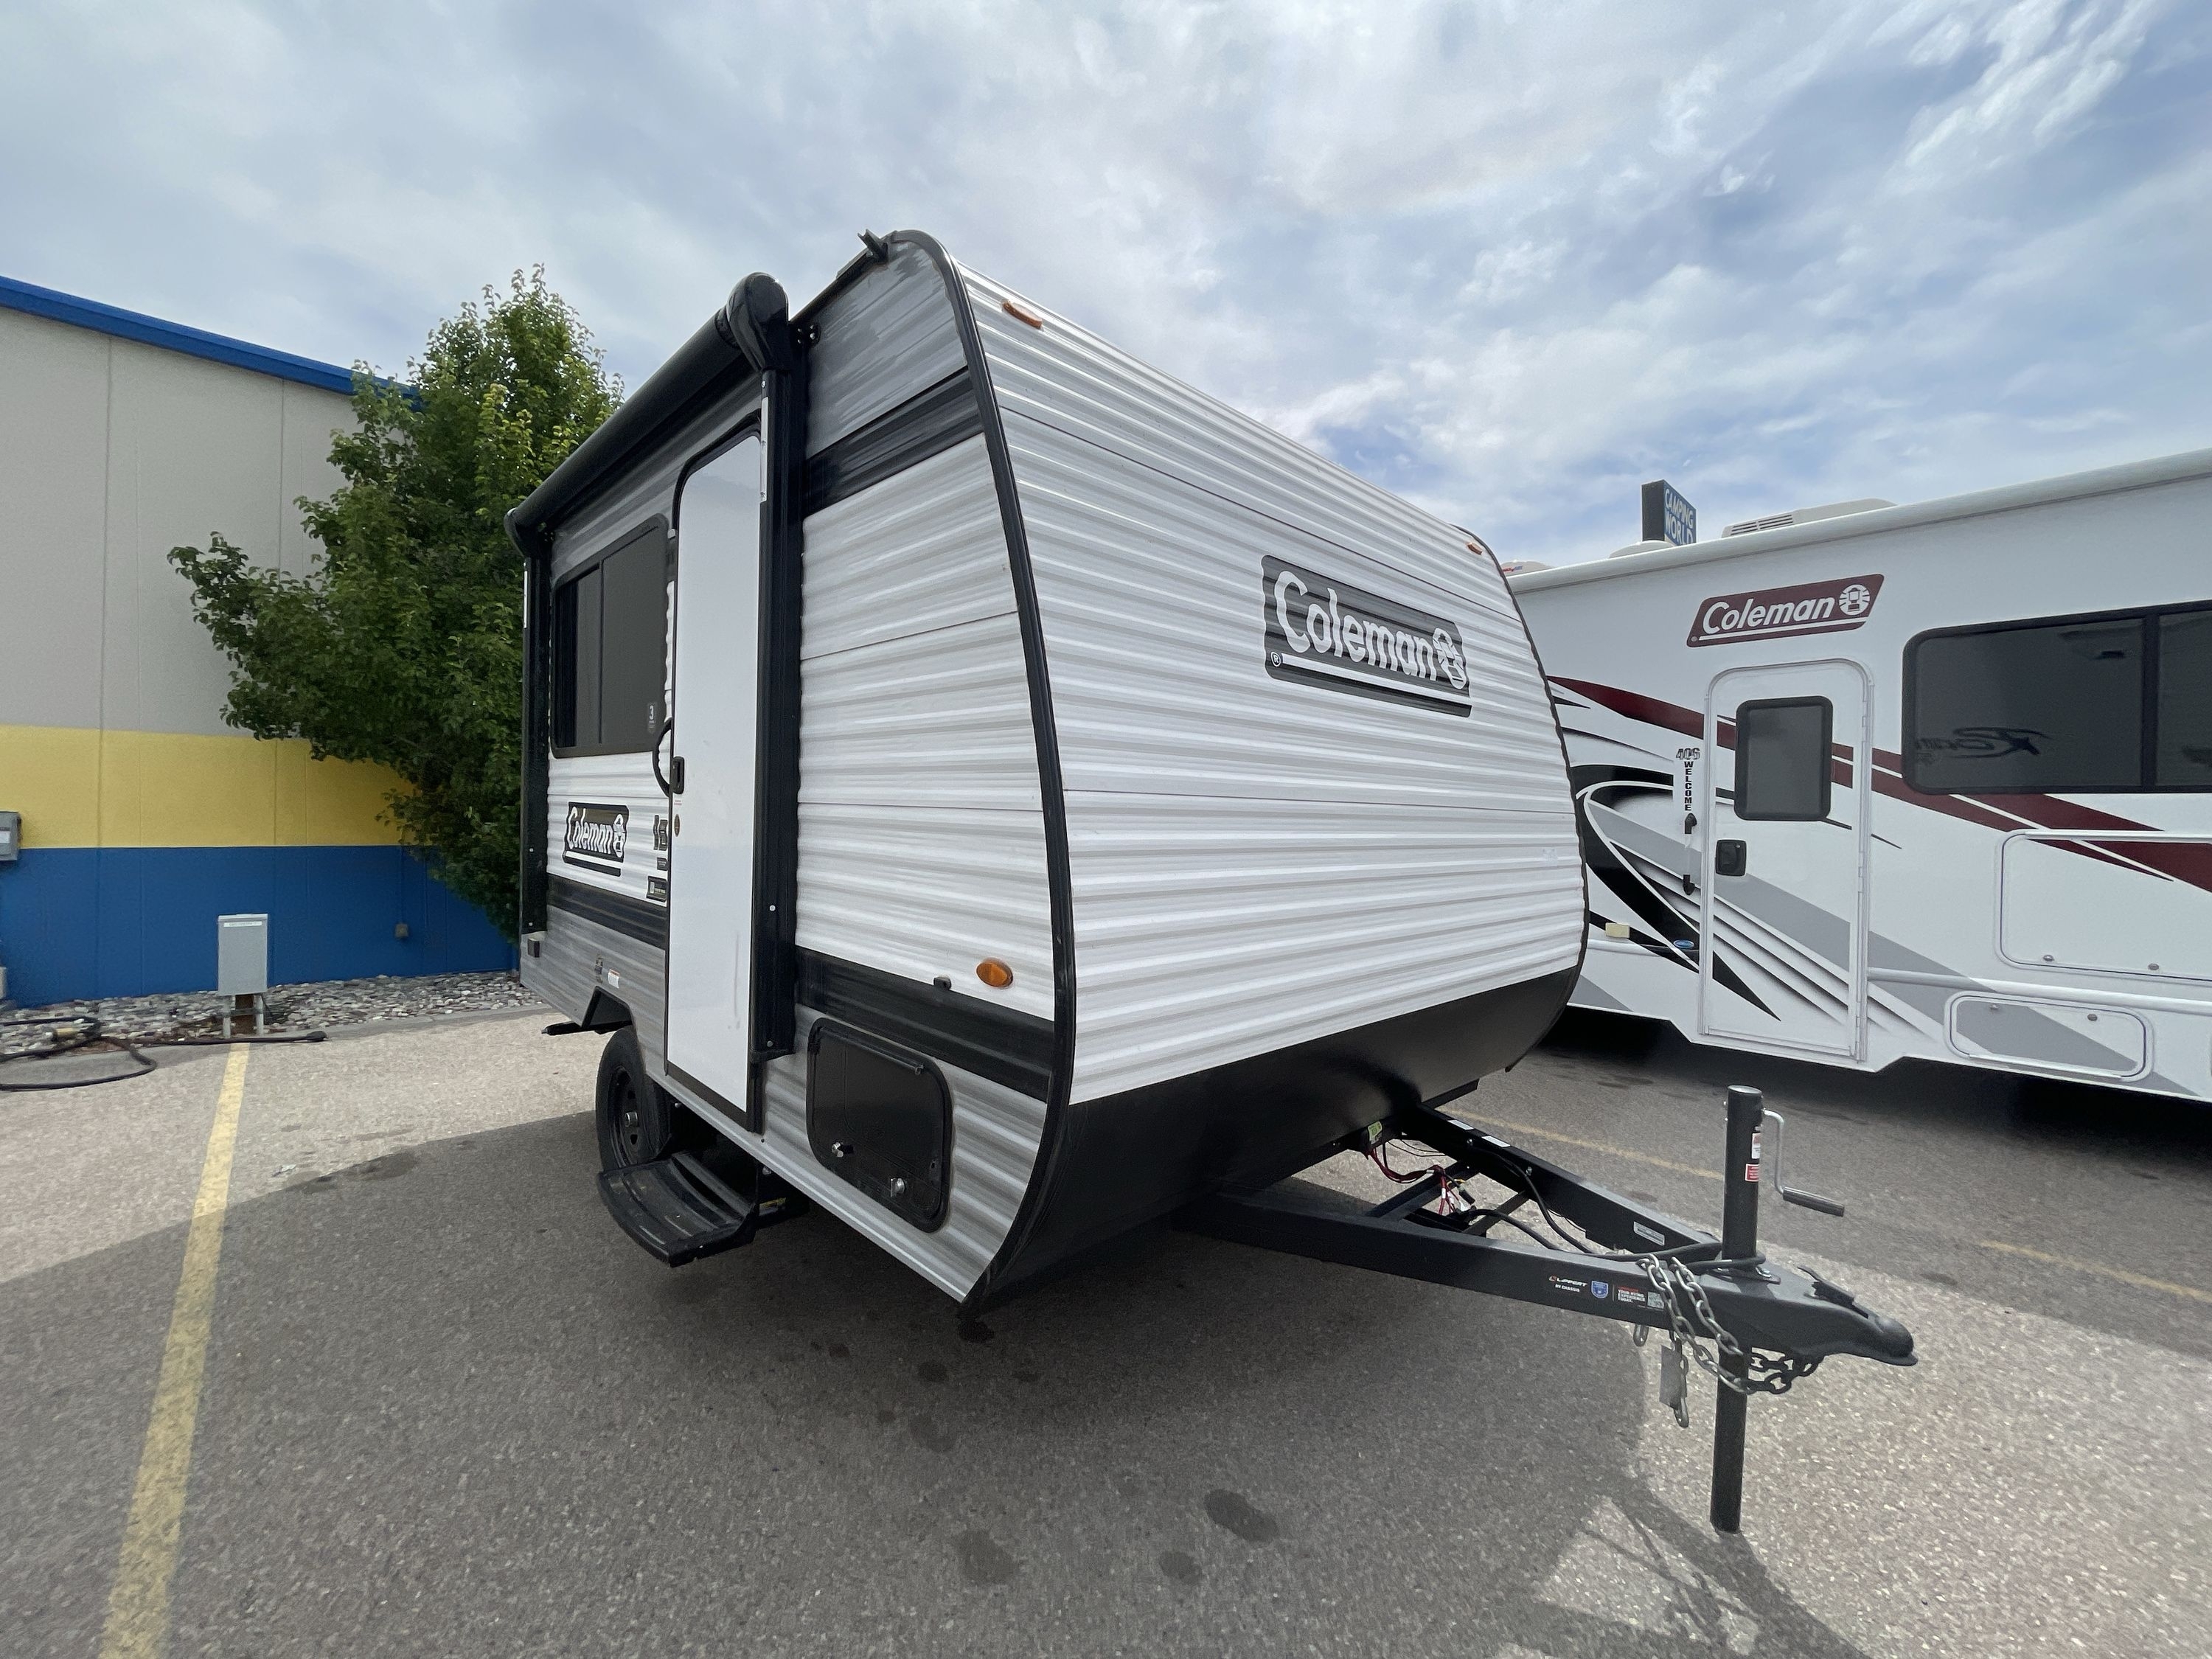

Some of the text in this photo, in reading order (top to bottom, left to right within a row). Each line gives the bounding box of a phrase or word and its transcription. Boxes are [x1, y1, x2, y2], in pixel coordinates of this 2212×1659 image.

[1665, 488, 1693, 529] CAMPING
[1666, 510, 1694, 545] WORLD
[1274, 571, 1437, 681] Coleman
[1703, 597, 1835, 635] Coleman
[1684, 761, 1694, 811] WELCOME
[567, 806, 613, 854] Coleman
